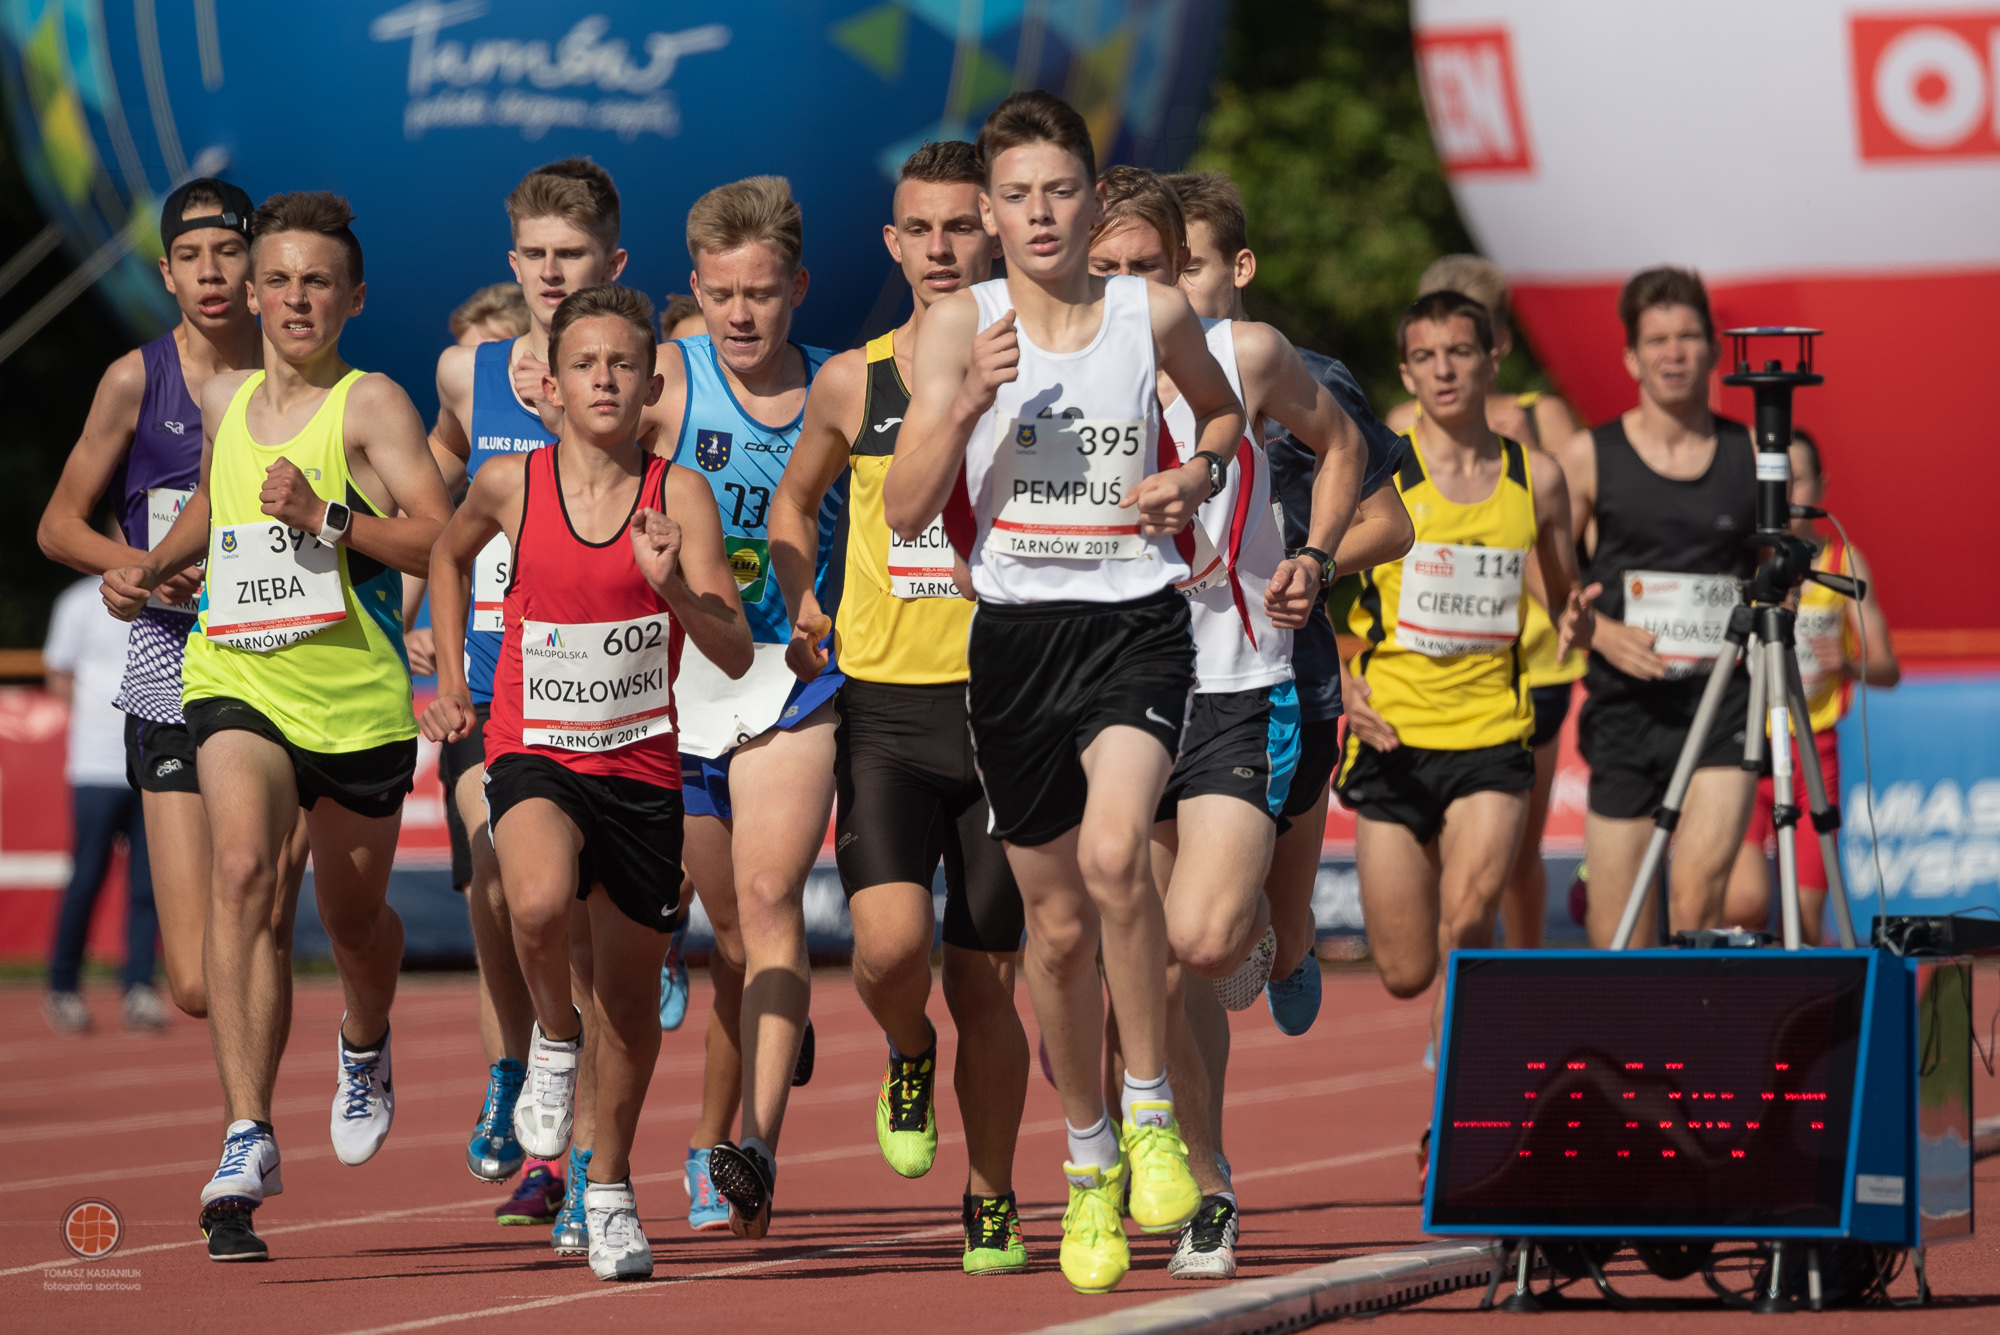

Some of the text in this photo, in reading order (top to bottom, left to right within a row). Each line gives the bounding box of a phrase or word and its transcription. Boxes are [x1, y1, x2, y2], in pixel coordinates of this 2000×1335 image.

[1872, 22, 2000, 150] O
[478, 436, 546, 451] MLUKS RAWA
[1076, 426, 1139, 456] 395
[724, 482, 770, 528] 73
[1013, 476, 1121, 506] PEMPUŚ
[1010, 537, 1119, 555] TARNÓW 2019
[495, 562, 511, 584] S
[1474, 553, 1520, 580] 114
[236, 575, 306, 606] ZIĘBA
[1417, 591, 1506, 617] CIERECH
[228, 631, 287, 649] TARNÓW
[603, 621, 662, 656] 602
[525, 648, 588, 659] MAŁOPOLSKA
[529, 668, 663, 703] KOZŁOWSKI
[548, 725, 648, 748] TARNÓW 2019
[1847, 777, 2000, 836] MIAS
